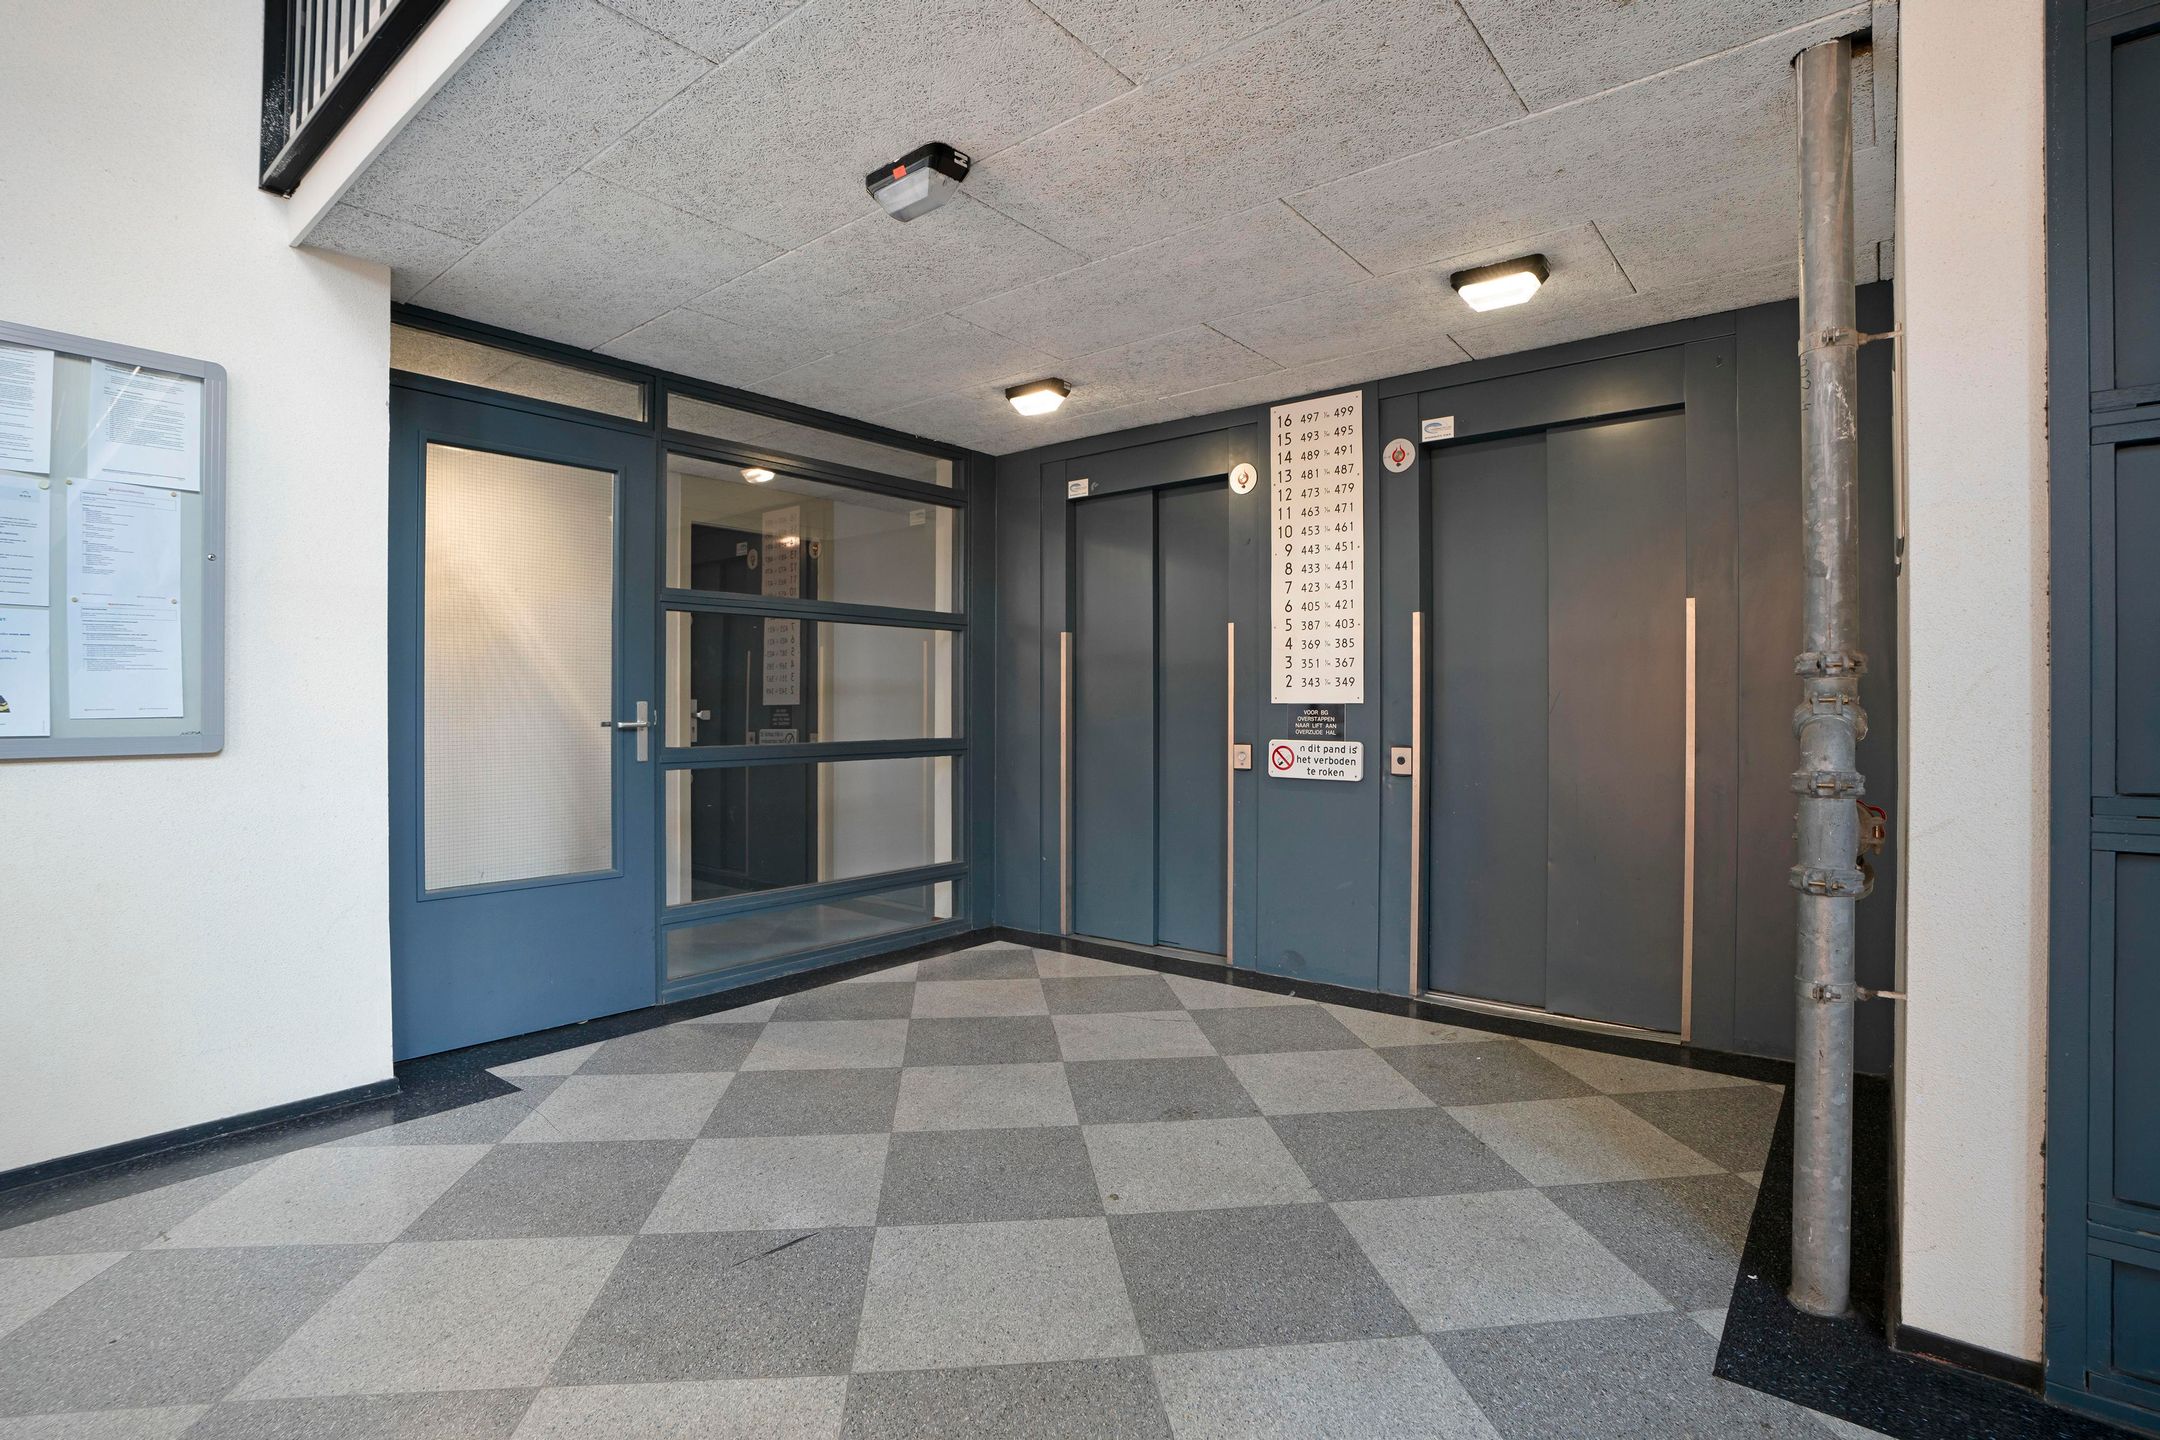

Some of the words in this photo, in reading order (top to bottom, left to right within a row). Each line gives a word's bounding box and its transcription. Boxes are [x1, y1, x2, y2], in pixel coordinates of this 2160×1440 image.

[1278, 414, 1292, 428] 16
[1301, 412, 1319, 423] 497
[1334, 406, 1353, 417] 499
[1278, 432, 1291, 446] 15
[1301, 431, 1319, 442] 493
[1334, 425, 1353, 436] 495
[1278, 451, 1292, 464] 14
[1301, 450, 1319, 460] 489
[1335, 444, 1352, 455] 491
[1278, 469, 1292, 483] 13
[1301, 469, 1318, 479] 481
[1335, 464, 1353, 474] 487
[1278, 488, 1291, 501] 12
[1301, 488, 1319, 498] 473
[1335, 483, 1354, 494] 479
[1278, 507, 1290, 520] 11
[1301, 506, 1319, 517] 463
[1335, 503, 1352, 513] 471
[1278, 525, 1292, 538] 10
[1301, 525, 1319, 535] 453
[1335, 522, 1353, 532] 461
[1285, 544, 1292, 556] 9
[1302, 544, 1320, 554] 443
[1335, 542, 1353, 551] 451
[1285, 563, 1292, 575] 8
[1302, 563, 1320, 573] 433
[1335, 561, 1353, 570] 441
[1285, 581, 1292, 594] 7
[1301, 582, 1320, 592] 423
[1335, 580, 1353, 590] 431
[1285, 600, 1292, 612] 6
[1301, 601, 1320, 611] 405
[1335, 600, 1353, 609] 421
[1286, 619, 1292, 631] 5
[1302, 620, 1320, 630] 387
[1335, 619, 1354, 628] 403
[1285, 637, 1292, 649] 4
[1302, 640, 1320, 649] 369
[1336, 638, 1354, 648] 385
[1286, 656, 1292, 668] 3
[1302, 659, 1319, 668] 351
[1336, 658, 1354, 667] 367
[1286, 675, 1292, 687] 2
[1302, 678, 1320, 687] 343
[1336, 677, 1355, 687] 349
[1324, 746, 1345, 754] pand
[1349, 746, 1357, 754] is
[1297, 755, 1311, 763] het
[1314, 757, 1356, 765] verboden
[1307, 767, 1315, 775] te
[1319, 768, 1344, 776] roken
